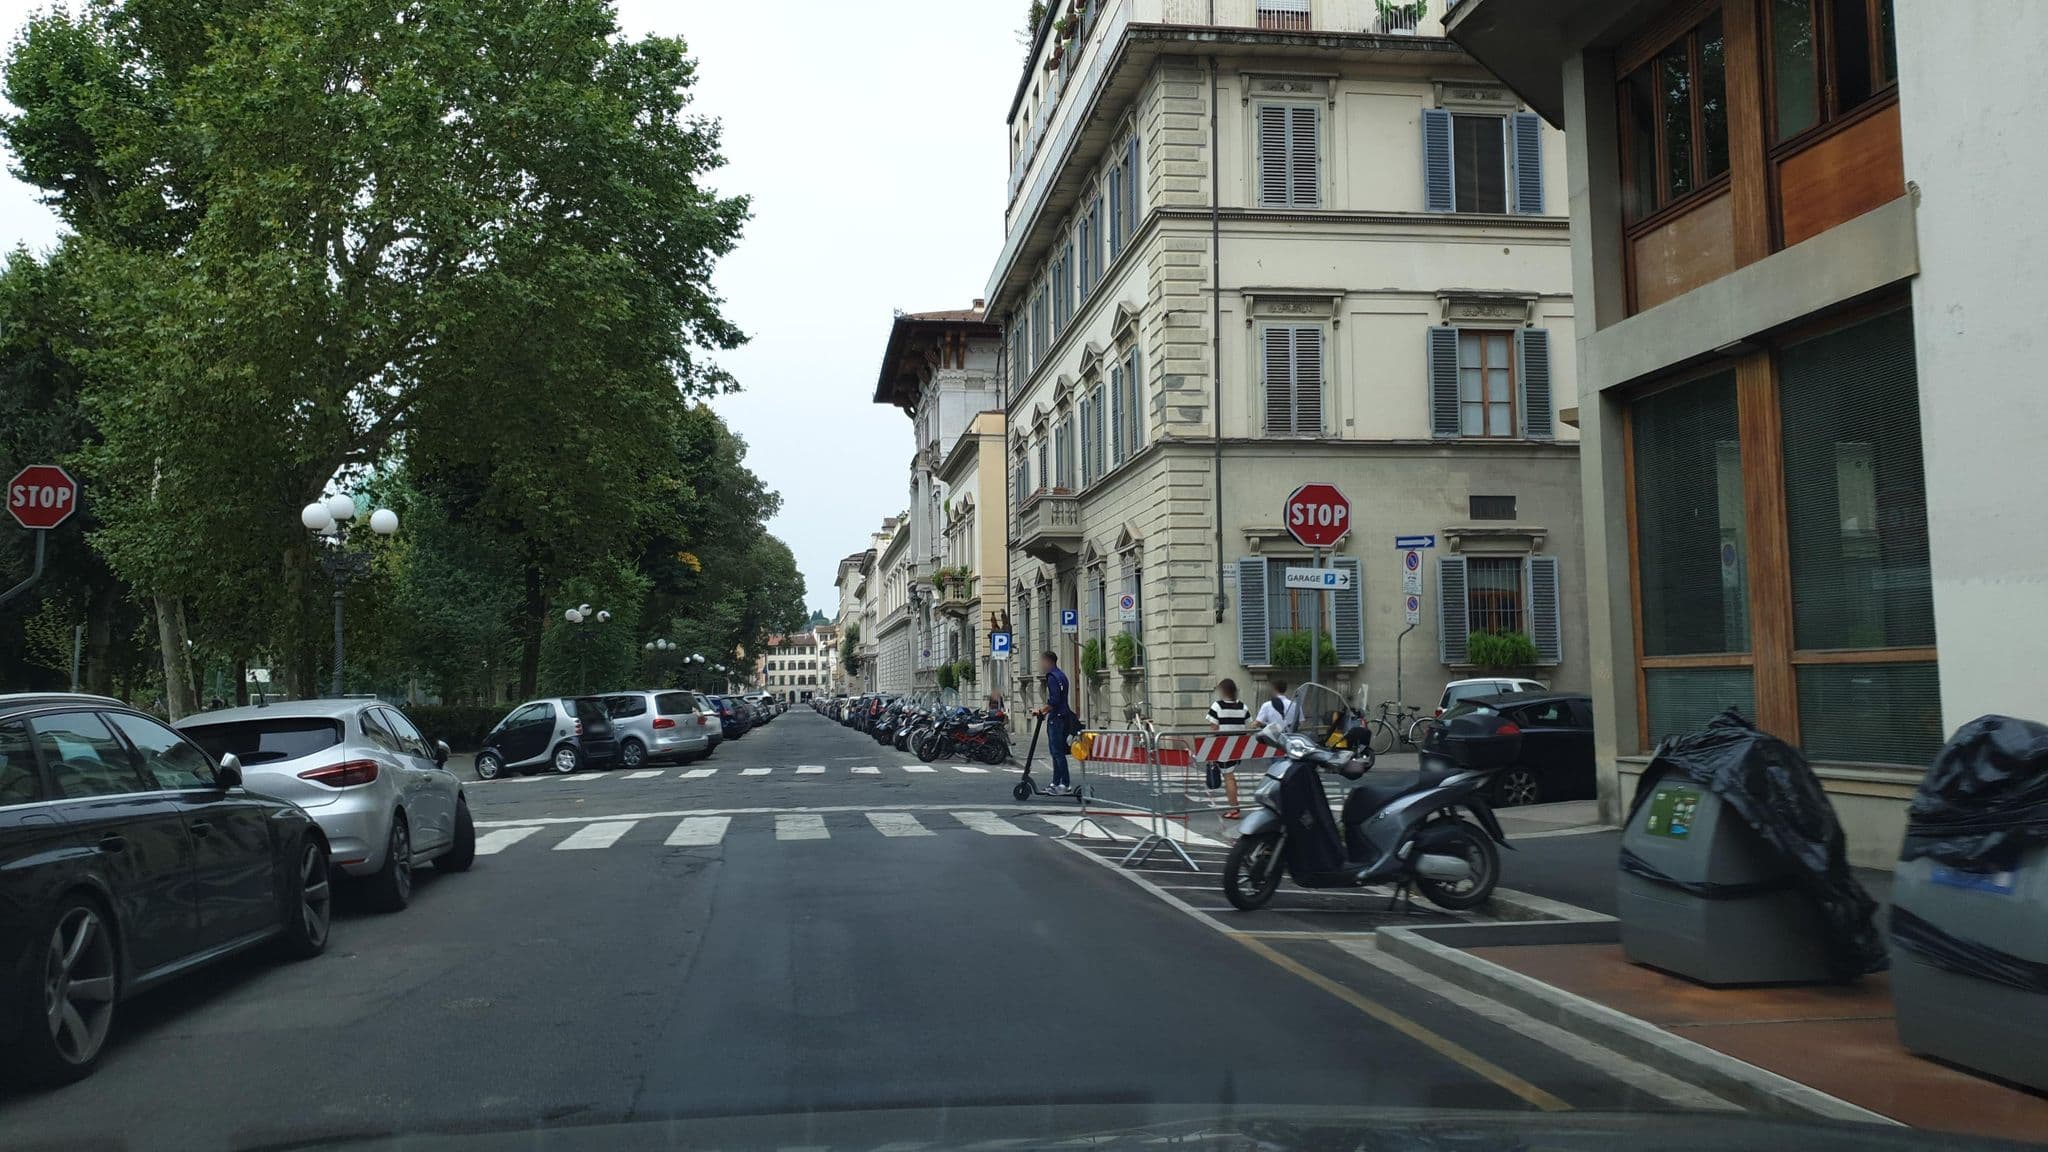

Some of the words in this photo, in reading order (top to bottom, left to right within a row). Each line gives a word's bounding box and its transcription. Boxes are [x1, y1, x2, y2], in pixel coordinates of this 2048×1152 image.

[12, 485, 71, 508] STOP
[1291, 503, 1347, 527] STOP
[1287, 574, 1321, 583] GARAGE
[1327, 575, 1334, 584] P
[1064, 611, 1074, 625] P
[994, 635, 1008, 650] P
